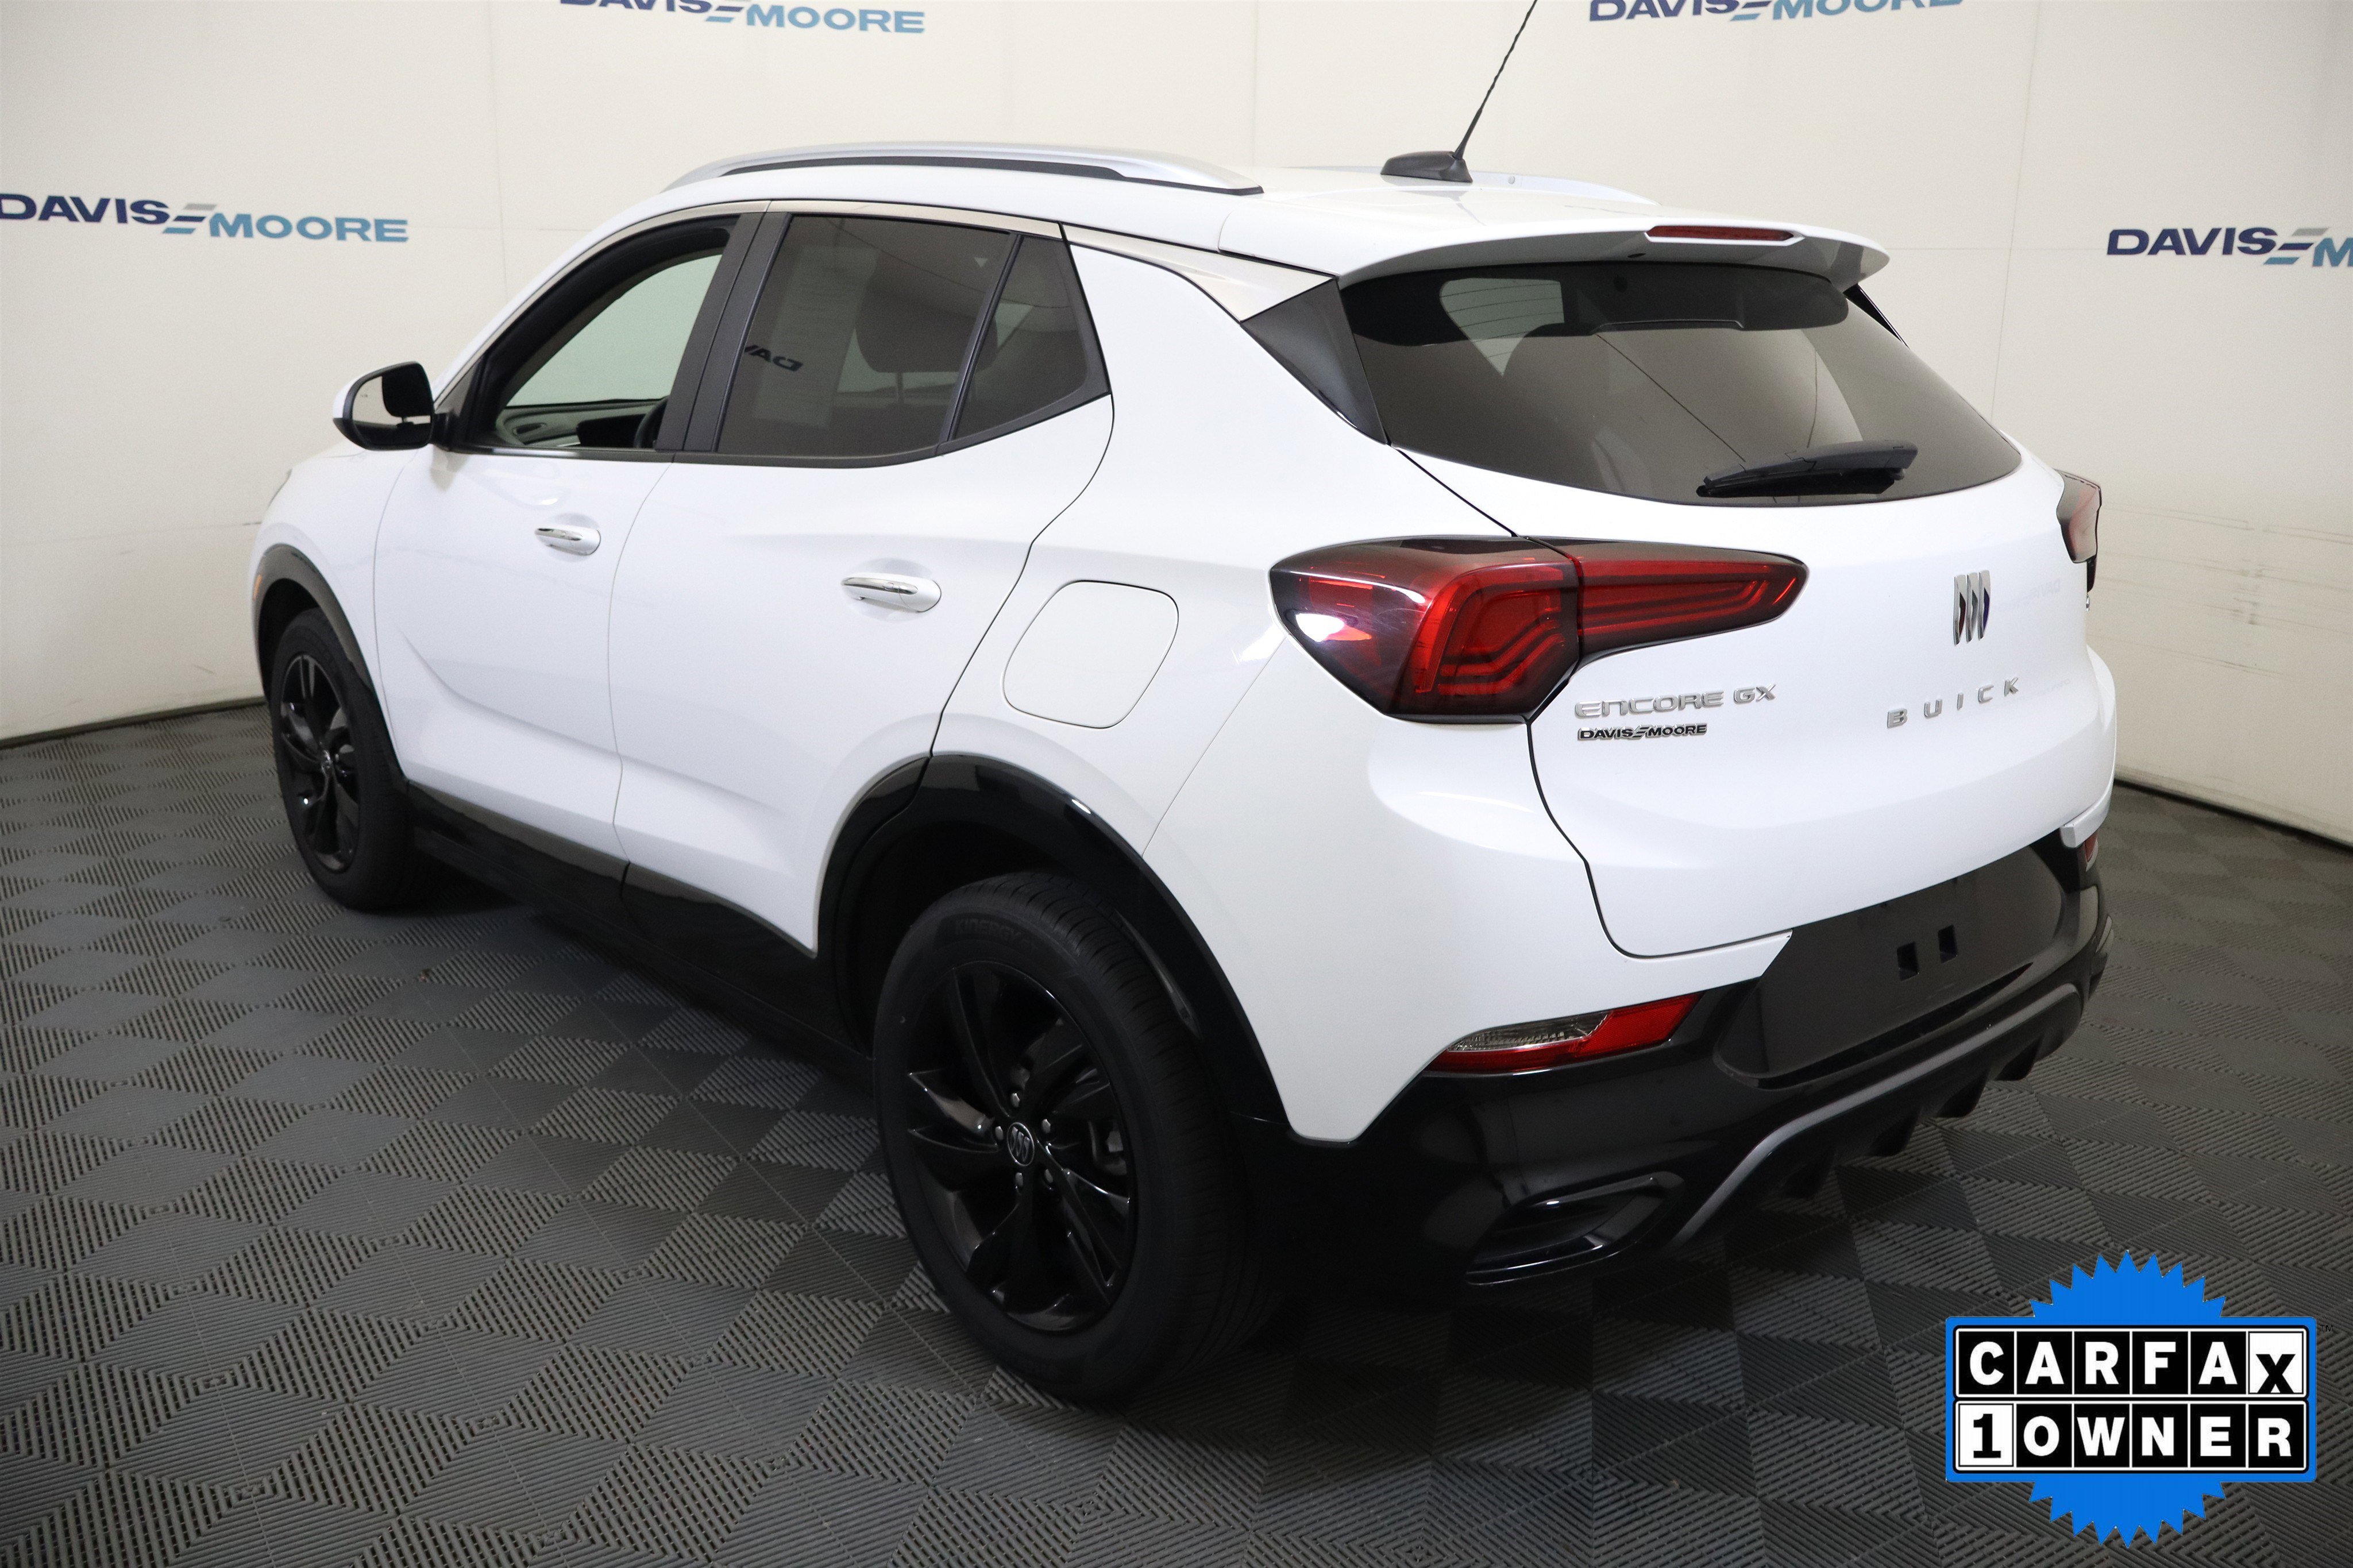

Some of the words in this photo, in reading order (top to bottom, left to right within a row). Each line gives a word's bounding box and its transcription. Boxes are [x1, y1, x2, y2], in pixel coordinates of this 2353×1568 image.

[747, 3, 925, 33] MOORE
[1773, 0, 1962, 20] MOO
[0, 193, 170, 225] DAVIS
[209, 213, 408, 242] MOORE
[2107, 227, 2278, 256] DAVIS
[1575, 690, 1725, 719] ENCORE
[1733, 683, 1776, 704] GX
[1887, 677, 2019, 728] BUICK
[1579, 727, 1634, 740] DAVIS
[1646, 723, 1707, 737] MOORE
